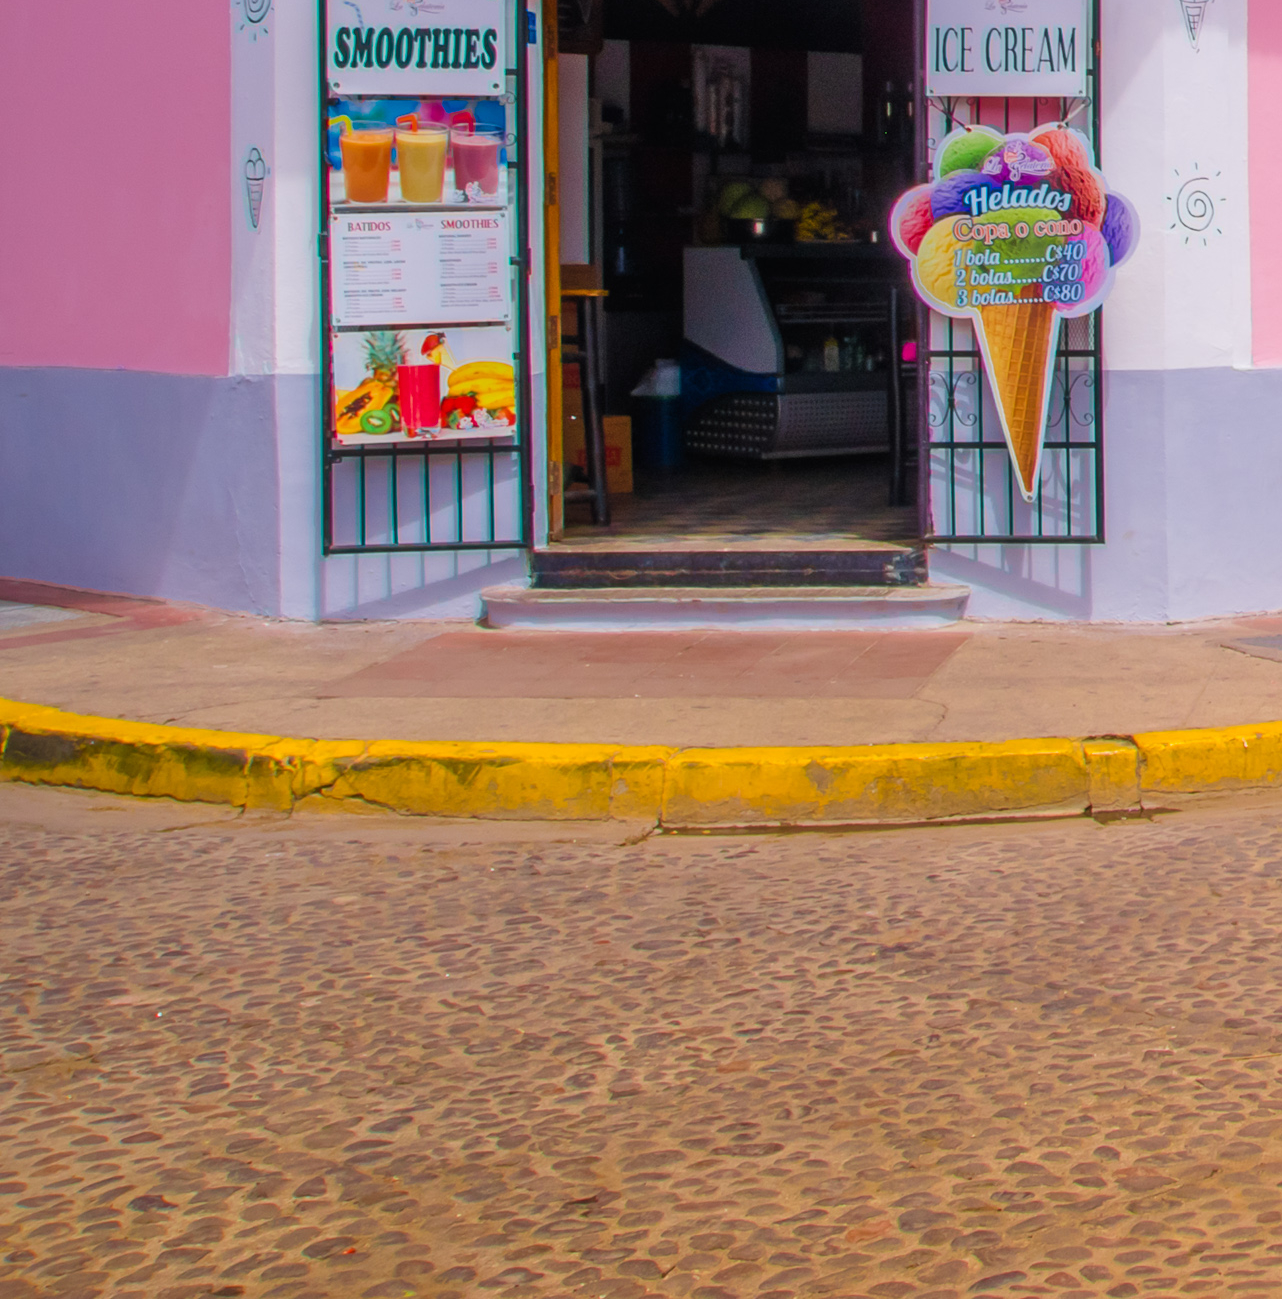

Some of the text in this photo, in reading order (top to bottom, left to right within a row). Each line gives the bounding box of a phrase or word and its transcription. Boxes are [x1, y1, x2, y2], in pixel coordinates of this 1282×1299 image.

[333, 26, 497, 70] SMOOTHIES
[934, 26, 1077, 73] ICE CREAM
[963, 184, 1072, 217] Helados
[347, 221, 391, 232] BATIDOS
[440, 218, 499, 230] SMOOTHIES
[953, 218, 1083, 245] Copa o cono
[954, 249, 962, 266] 1
[956, 269, 967, 286] 2
[957, 289, 968, 306] 3
